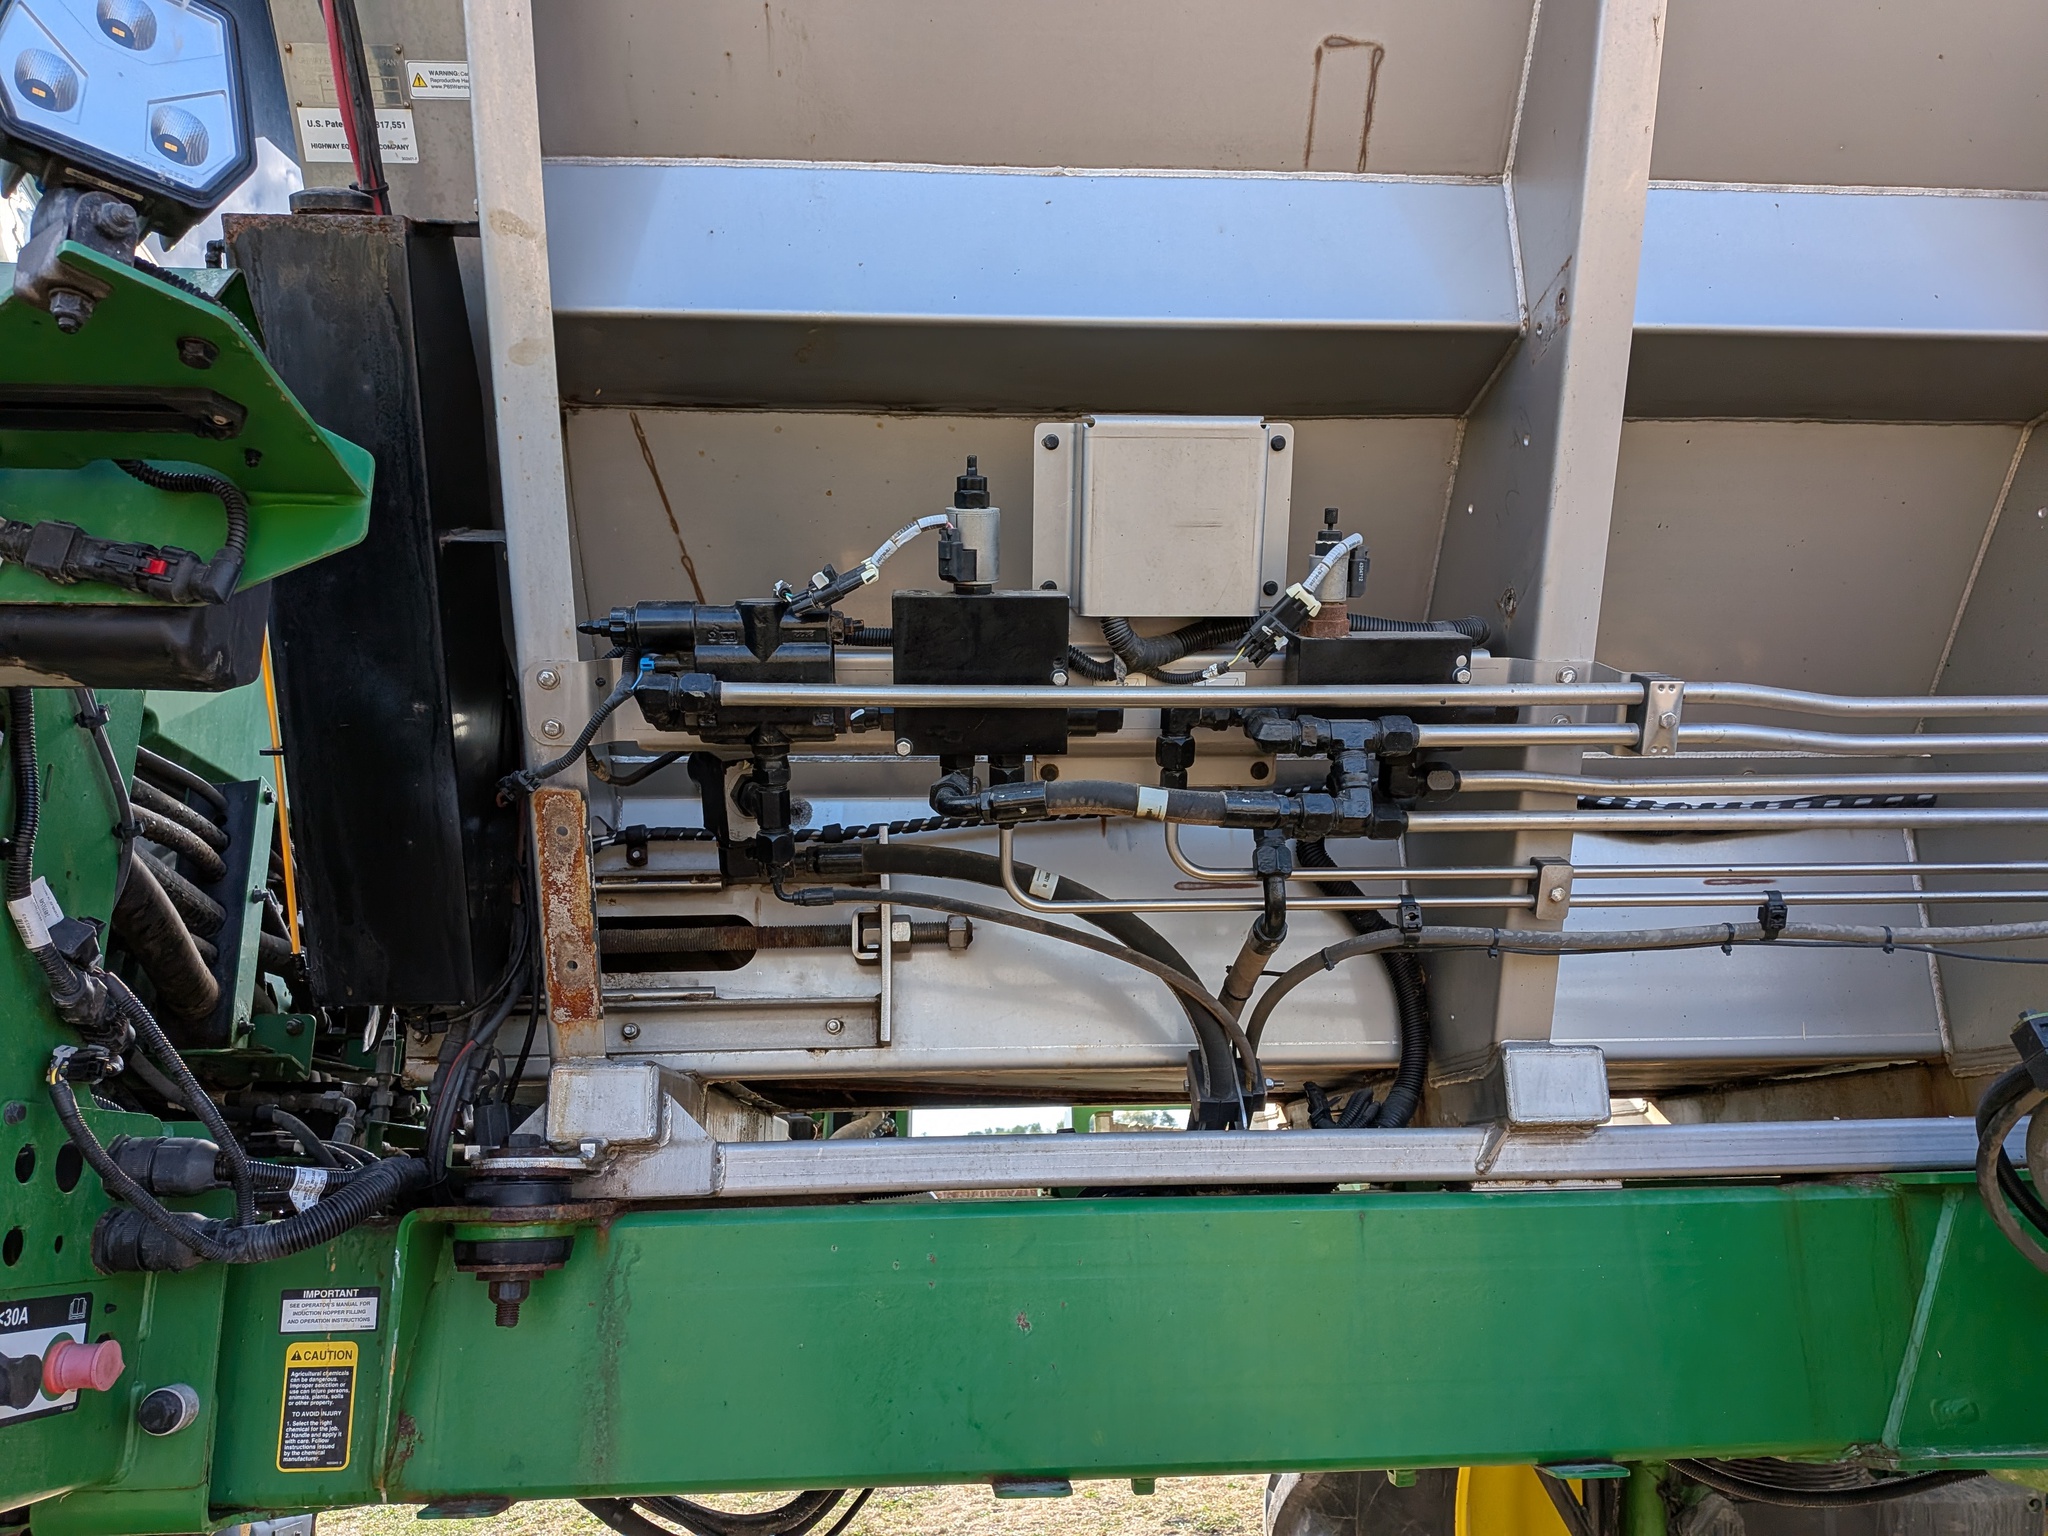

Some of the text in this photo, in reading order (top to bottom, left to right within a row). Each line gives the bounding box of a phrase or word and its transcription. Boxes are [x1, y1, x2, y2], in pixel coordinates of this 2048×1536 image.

[306, 120, 324, 128] U.S.
[303, 1289, 359, 1298] IMPORTANT
[304, 1350, 353, 1361] CAUTION
